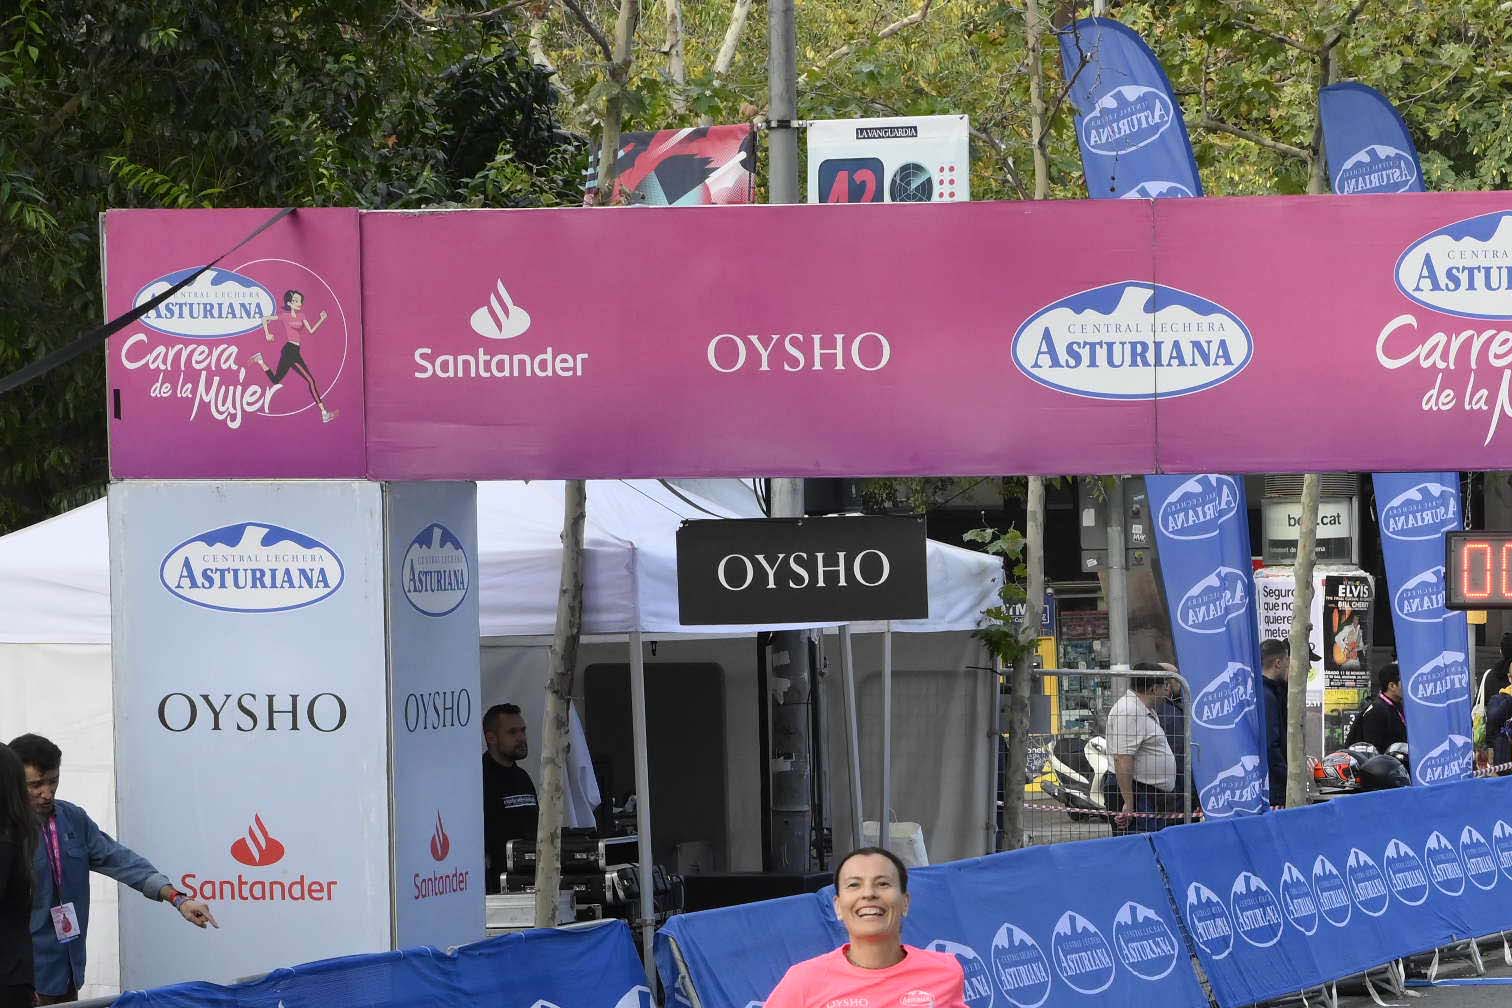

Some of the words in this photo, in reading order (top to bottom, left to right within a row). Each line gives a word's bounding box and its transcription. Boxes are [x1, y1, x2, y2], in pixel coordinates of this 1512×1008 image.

[1068, 322, 1142, 334] CENTRAL
[1150, 321, 1226, 333] LECHERA
[121, 333, 237, 370] Carrera
[415, 348, 588, 379] Santander
[707, 332, 891, 373] OYSHO
[1031, 326, 1234, 369] ASTURIANA
[150, 376, 172, 398] de
[176, 373, 192, 398] la
[190, 366, 283, 429] Mujer
[1422, 372, 1456, 411] de
[1464, 370, 1488, 410] la
[175, 556, 331, 590] ASTURIANA
[203, 554, 261, 563] CENTRAL
[266, 553, 324, 562] LECHERA
[717, 549, 891, 592] OYSHO
[407, 559, 465, 593] ASTURIANA
[1338, 585, 1368, 597] ELVIS
[1264, 602, 1279, 612] que
[157, 692, 347, 733] OYSHO
[404, 688, 471, 733] OYSHO
[181, 873, 337, 902] Santander
[413, 867, 469, 900] Santander
[997, 959, 1048, 990] ASTURIANA
[1058, 945, 1112, 977] ASTURIANA
